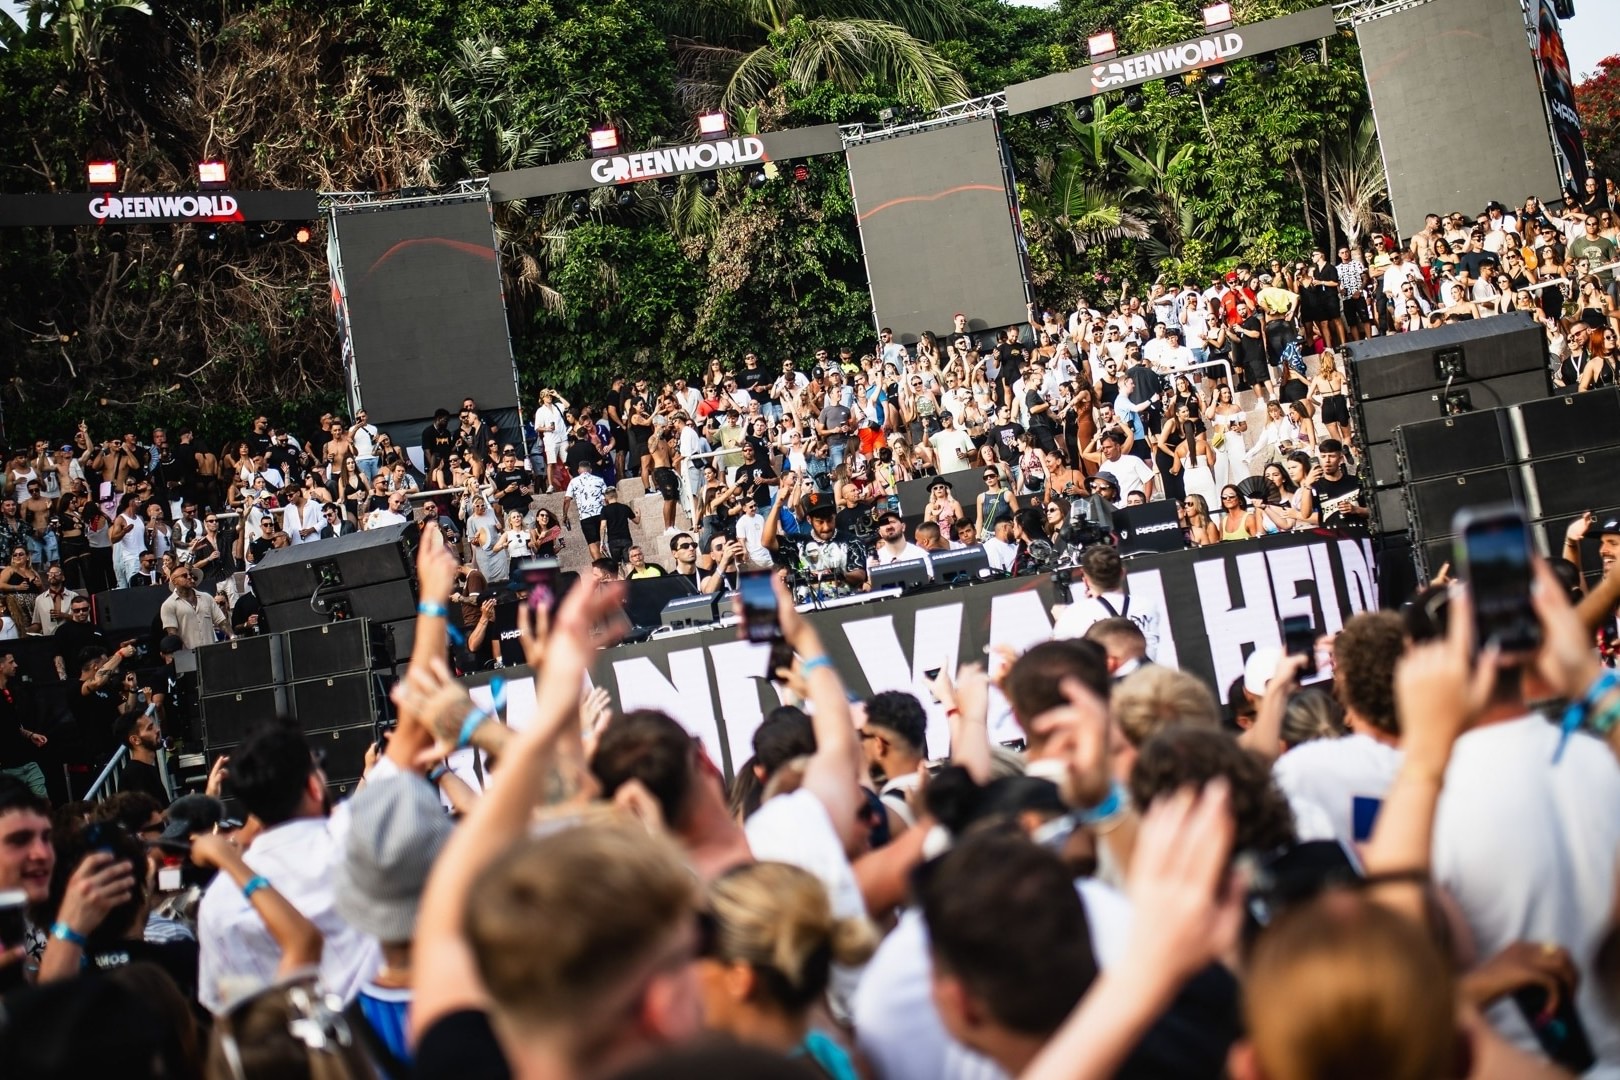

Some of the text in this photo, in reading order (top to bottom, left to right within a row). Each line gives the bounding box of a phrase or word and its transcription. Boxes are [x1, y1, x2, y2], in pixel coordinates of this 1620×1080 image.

[1090, 33, 1243, 88] GREENWORLD
[590, 137, 764, 184] GREENWORLD
[88, 195, 238, 219] GREENWORLD
